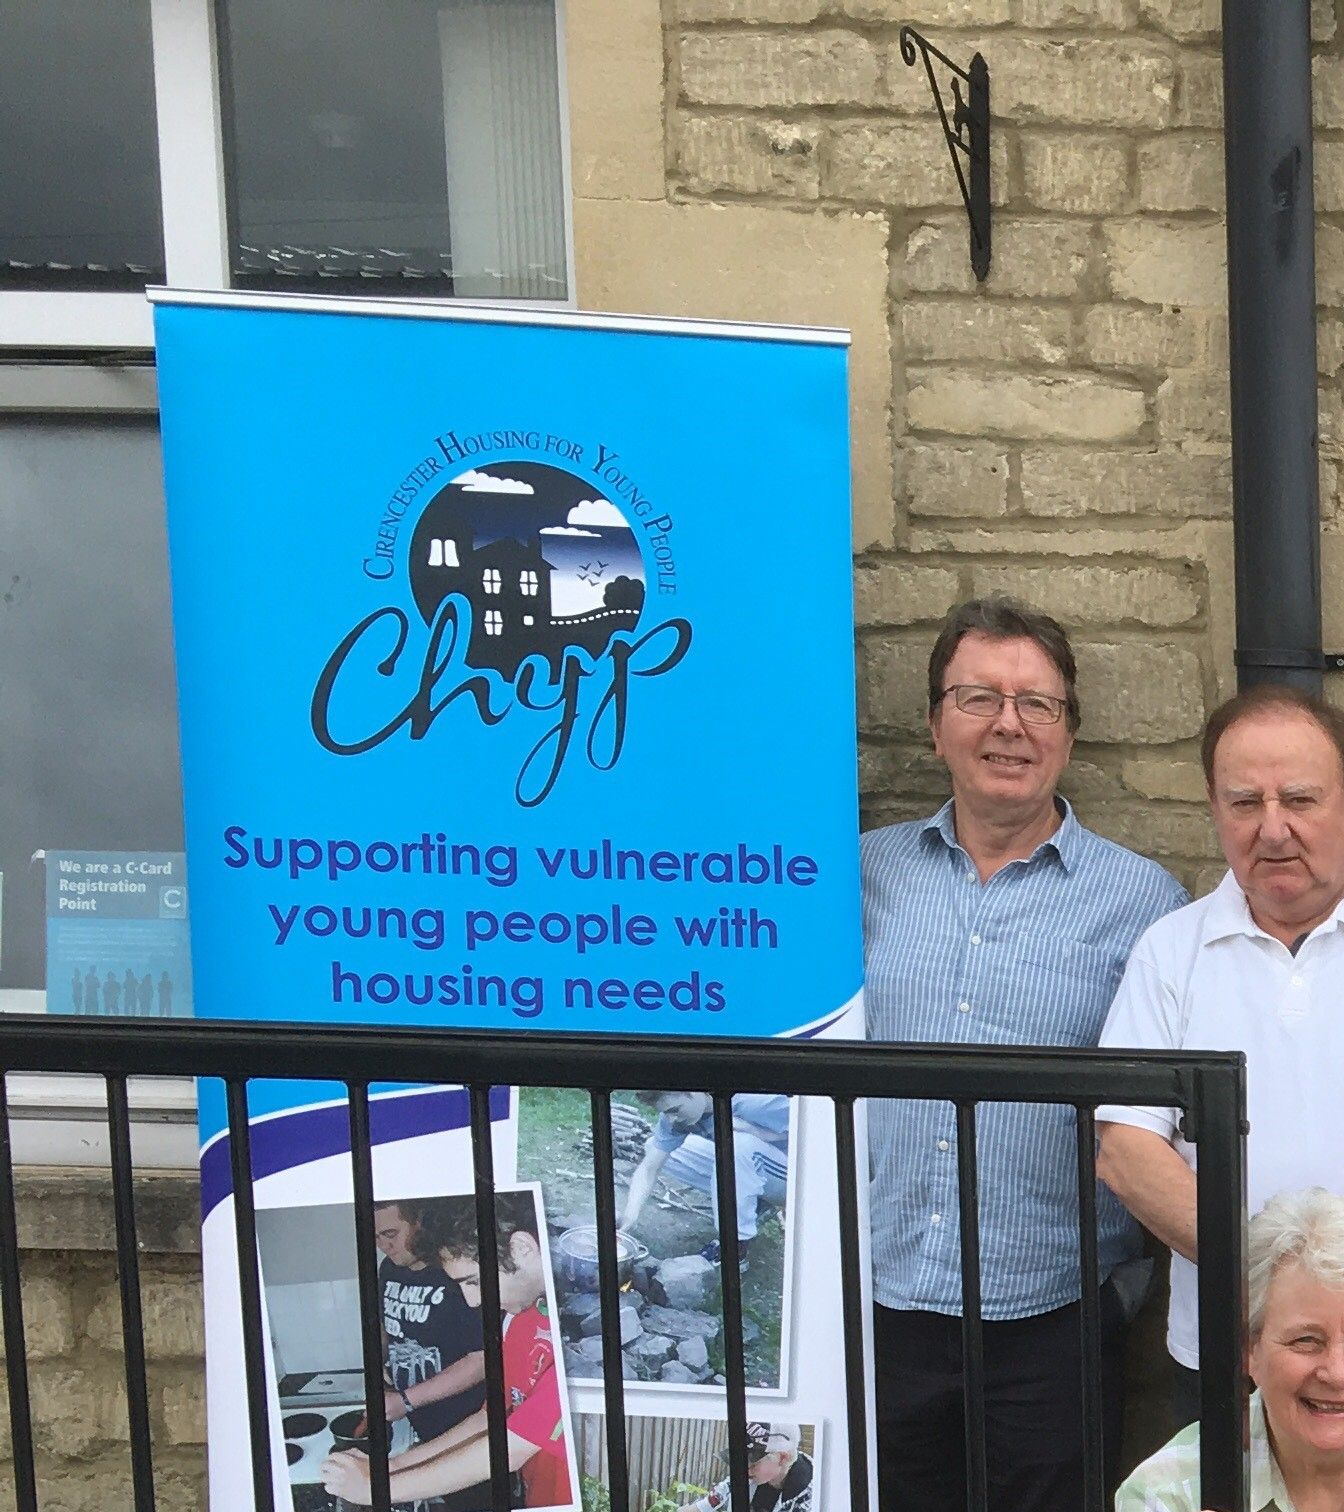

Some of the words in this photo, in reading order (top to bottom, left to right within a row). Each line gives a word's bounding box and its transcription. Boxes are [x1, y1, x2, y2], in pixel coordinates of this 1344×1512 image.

[434, 430, 540, 466] HOUSING
[591, 443, 653, 517] YOUNG
[643, 512, 677, 597] PEOPLE
[309, 597, 693, 808] Chyp
[59, 860, 81, 874] We
[85, 863, 108, 875] are
[112, 863, 122, 875] a
[125, 861, 173, 876] C-Card
[222, 825, 518, 887] Supporting
[536, 839, 819, 887] vulnerable
[59, 879, 147, 895] Registration
[59, 897, 97, 911] Point
[268, 903, 446, 951] young
[465, 906, 658, 954] people
[673, 905, 780, 950] with
[330, 961, 545, 1018] housing
[563, 971, 727, 1013] needs
